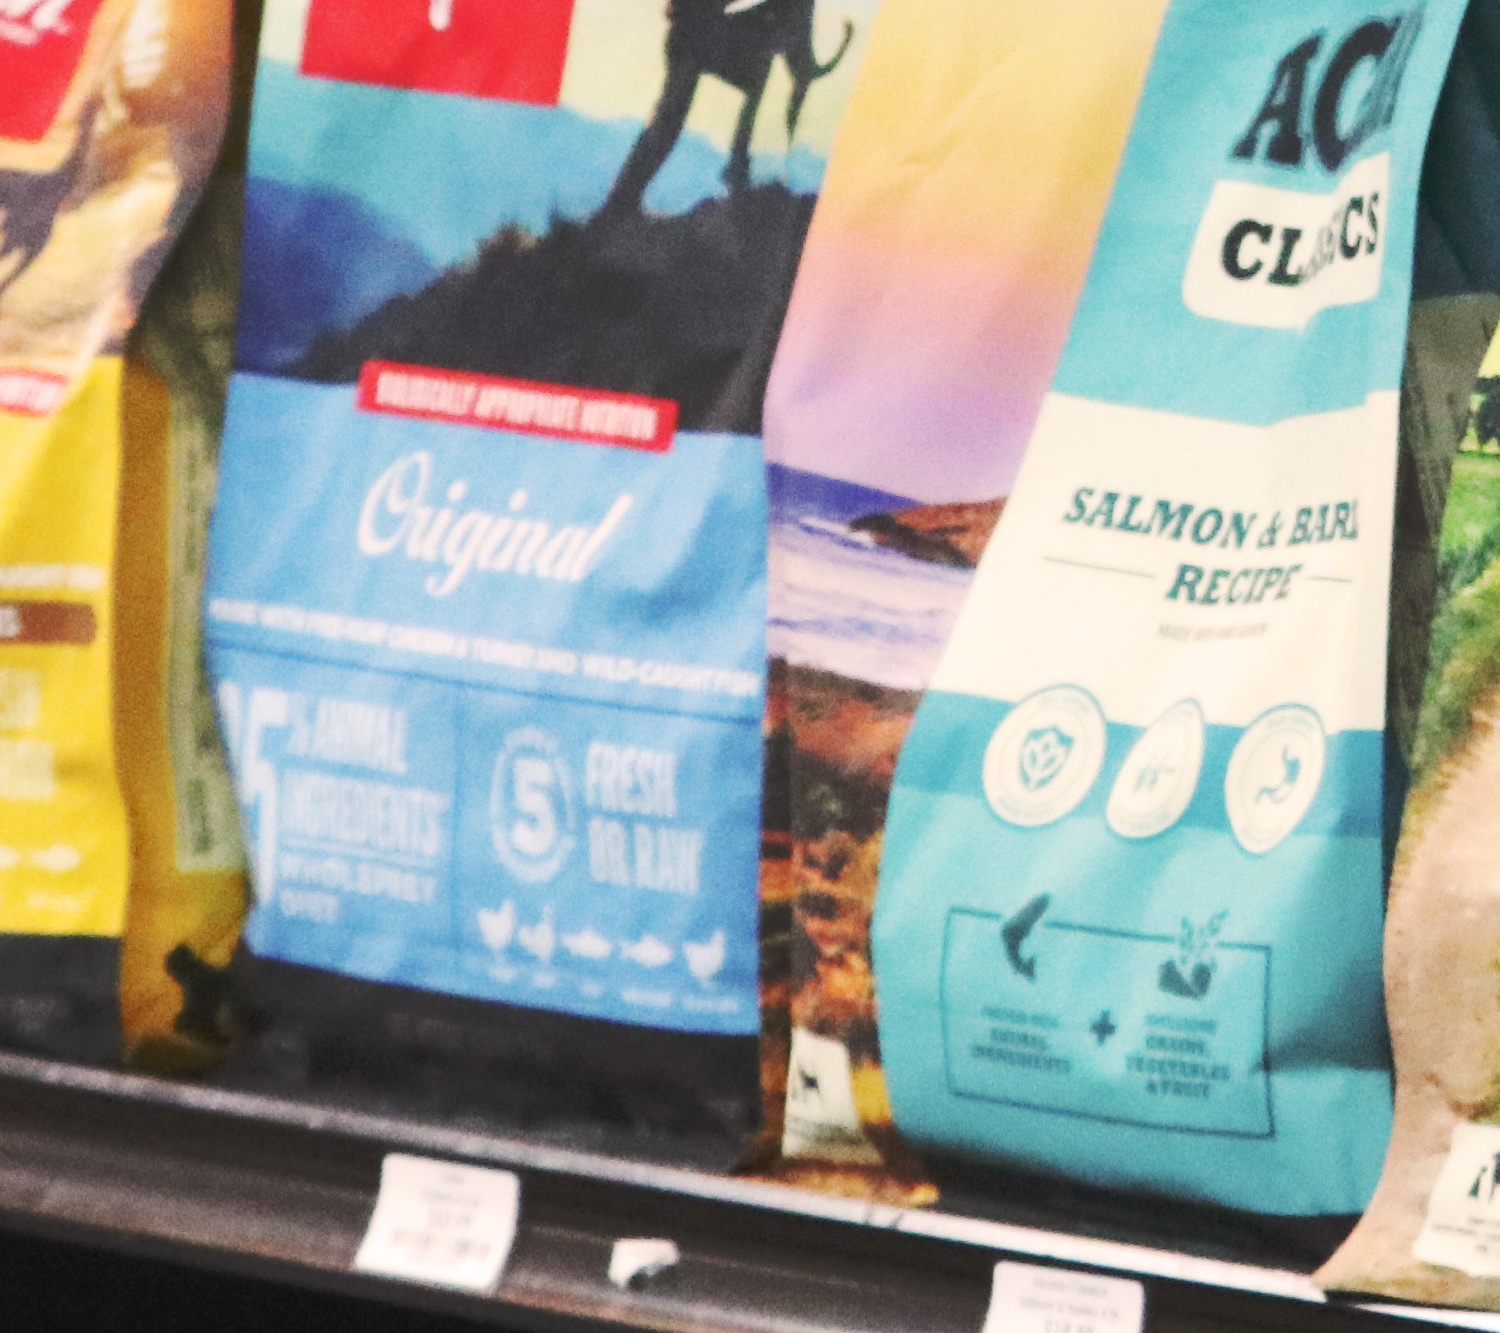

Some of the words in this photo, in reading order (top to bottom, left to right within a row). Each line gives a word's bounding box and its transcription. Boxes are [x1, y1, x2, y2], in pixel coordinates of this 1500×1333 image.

[359, 451, 632, 597] Original
[1063, 488, 1252, 552] SALMON
[1259, 514, 1279, 547] &
[1166, 561, 1303, 609] RECIPE
